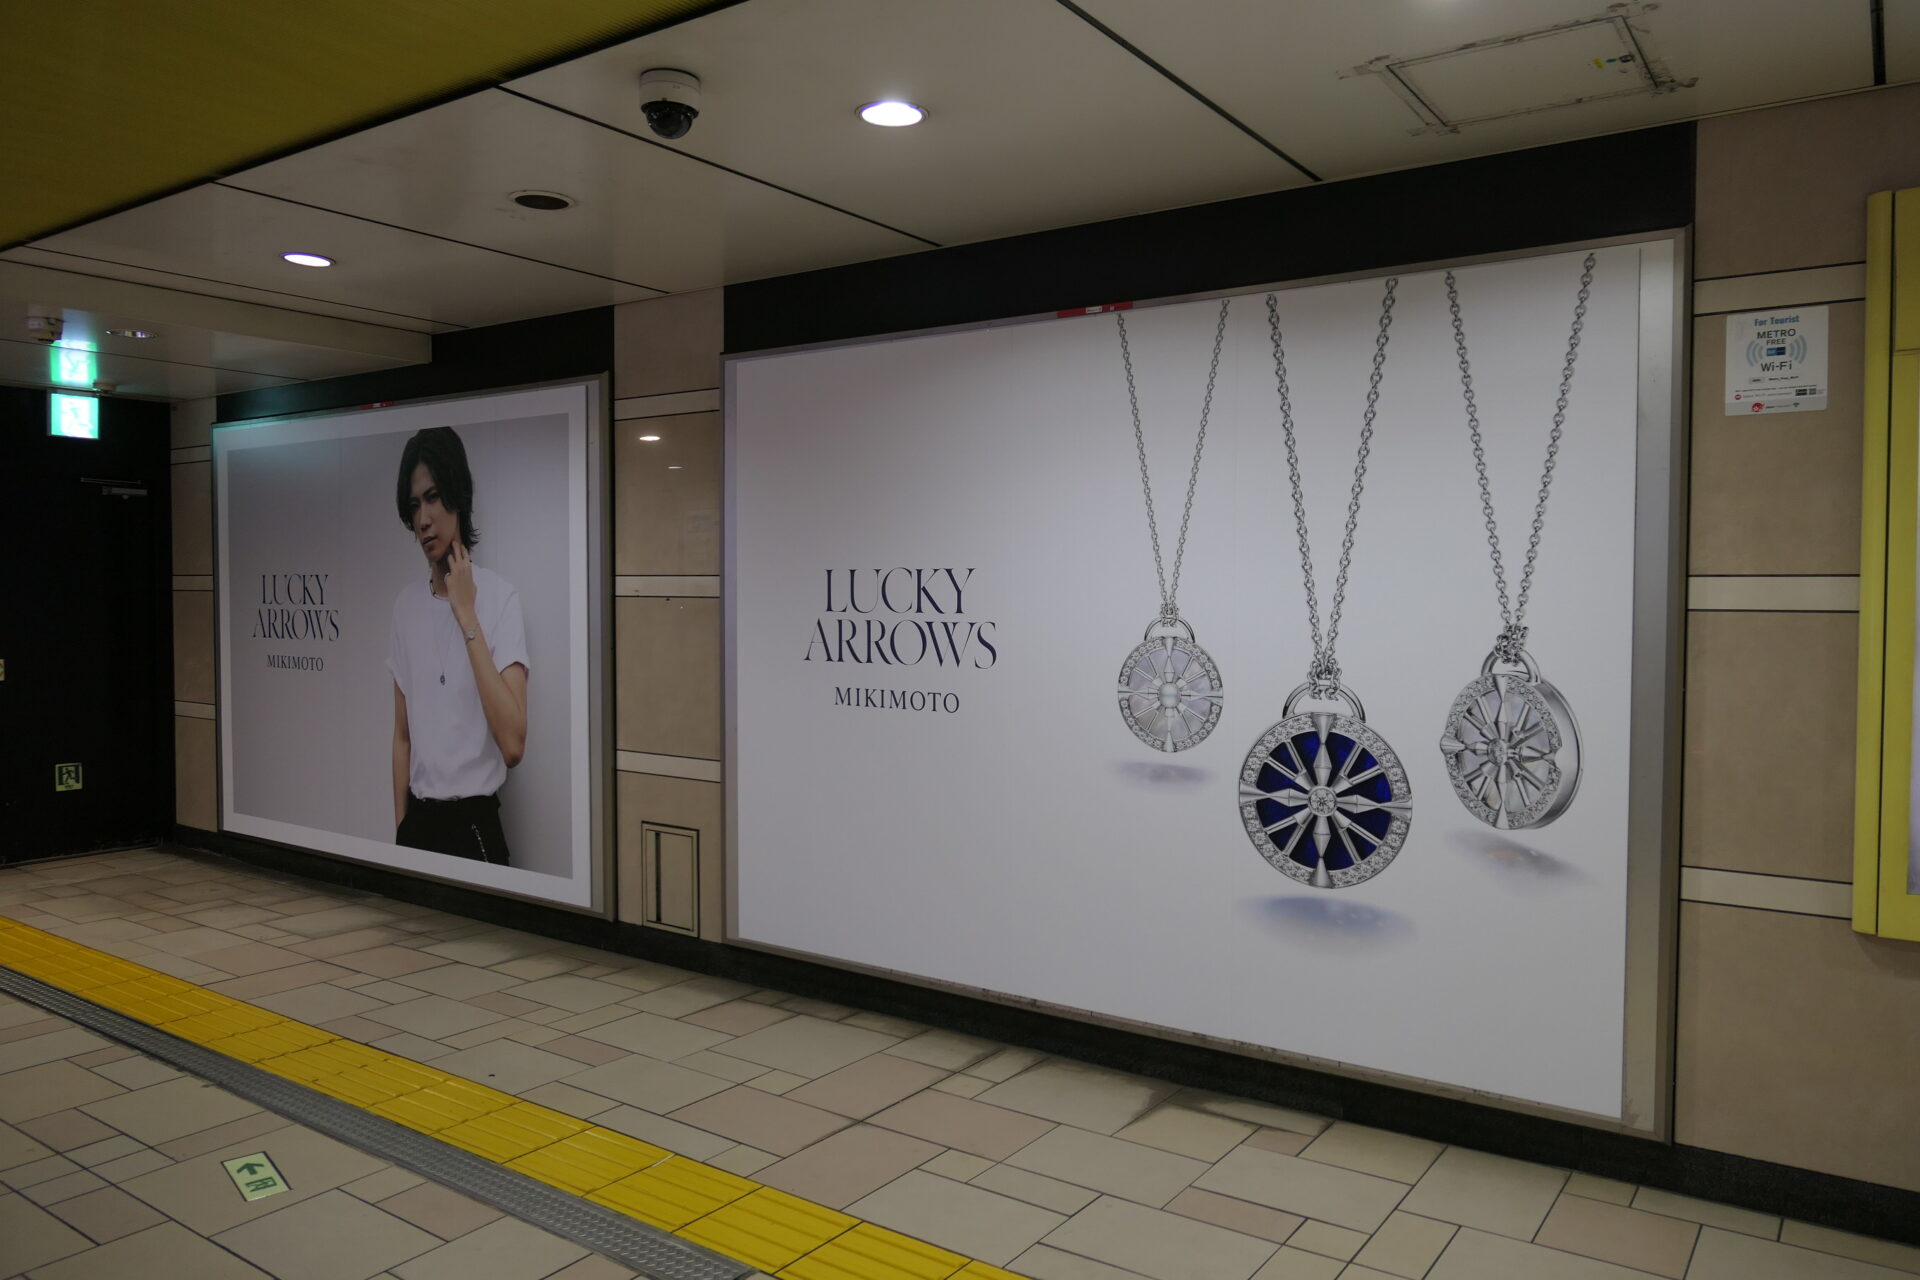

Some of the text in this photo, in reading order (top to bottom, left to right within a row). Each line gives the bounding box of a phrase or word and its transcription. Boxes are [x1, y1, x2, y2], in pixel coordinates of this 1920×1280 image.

[1754, 315, 1799, 326] For Tourist
[1757, 328, 1796, 339] METRO
[1766, 338, 1786, 346] FREE
[1760, 360, 1792, 372] Wi-Fi
[262, 574, 328, 605] LUCKY
[824, 567, 976, 614] LUCKY
[253, 608, 339, 642] ARROWS
[803, 618, 997, 669] ARROWS
[267, 654, 324, 672] MIKIMOTO
[834, 686, 960, 714] MIKIMOTO
